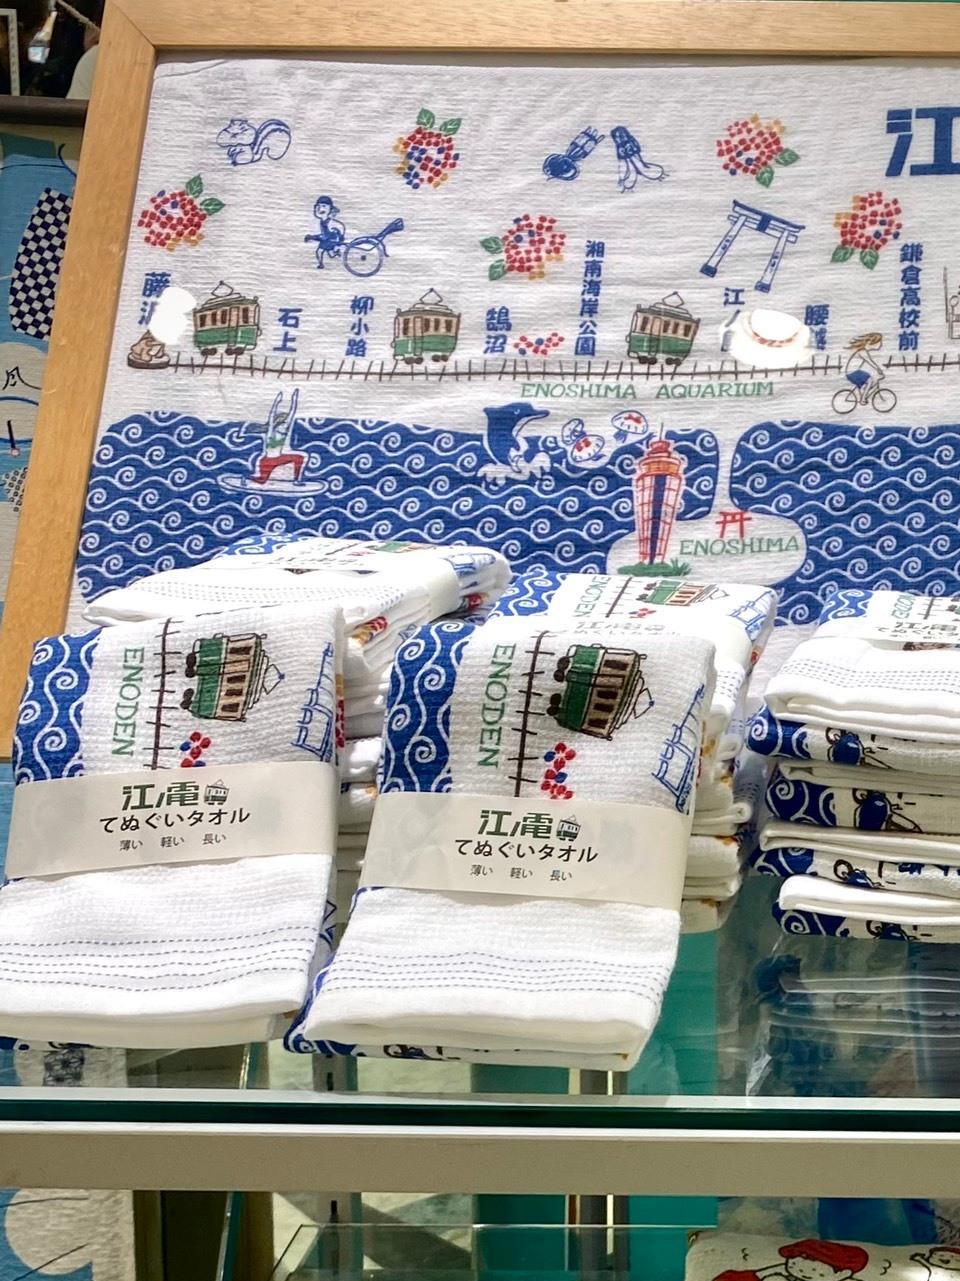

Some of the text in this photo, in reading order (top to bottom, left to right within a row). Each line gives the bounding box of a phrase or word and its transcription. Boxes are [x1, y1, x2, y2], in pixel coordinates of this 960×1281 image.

[574, 240, 605, 357] 湘南海岸公園
[899, 243, 924, 350] 鎌倉高校前
[273, 308, 303, 352] 石上
[345, 296, 374, 357] 柳小路
[483, 306, 512, 354] 鵠沼
[521, 381, 774, 399] ENOSHIMA AQUARIUM
[679, 536, 799, 556] ENOSHIMA
[112, 647, 144, 757] ENODEN
[477, 643, 517, 768] ENODEN
[121, 781, 200, 811] 江ノ電
[100, 807, 250, 834] てぬぐいタオル
[477, 809, 554, 839] 江ノ電
[119, 833, 226, 852] 薄い 軽い 長い
[454, 839, 598, 863] てぬぐいタオル
[470, 864, 573, 881] 薄い 軽い 長い
